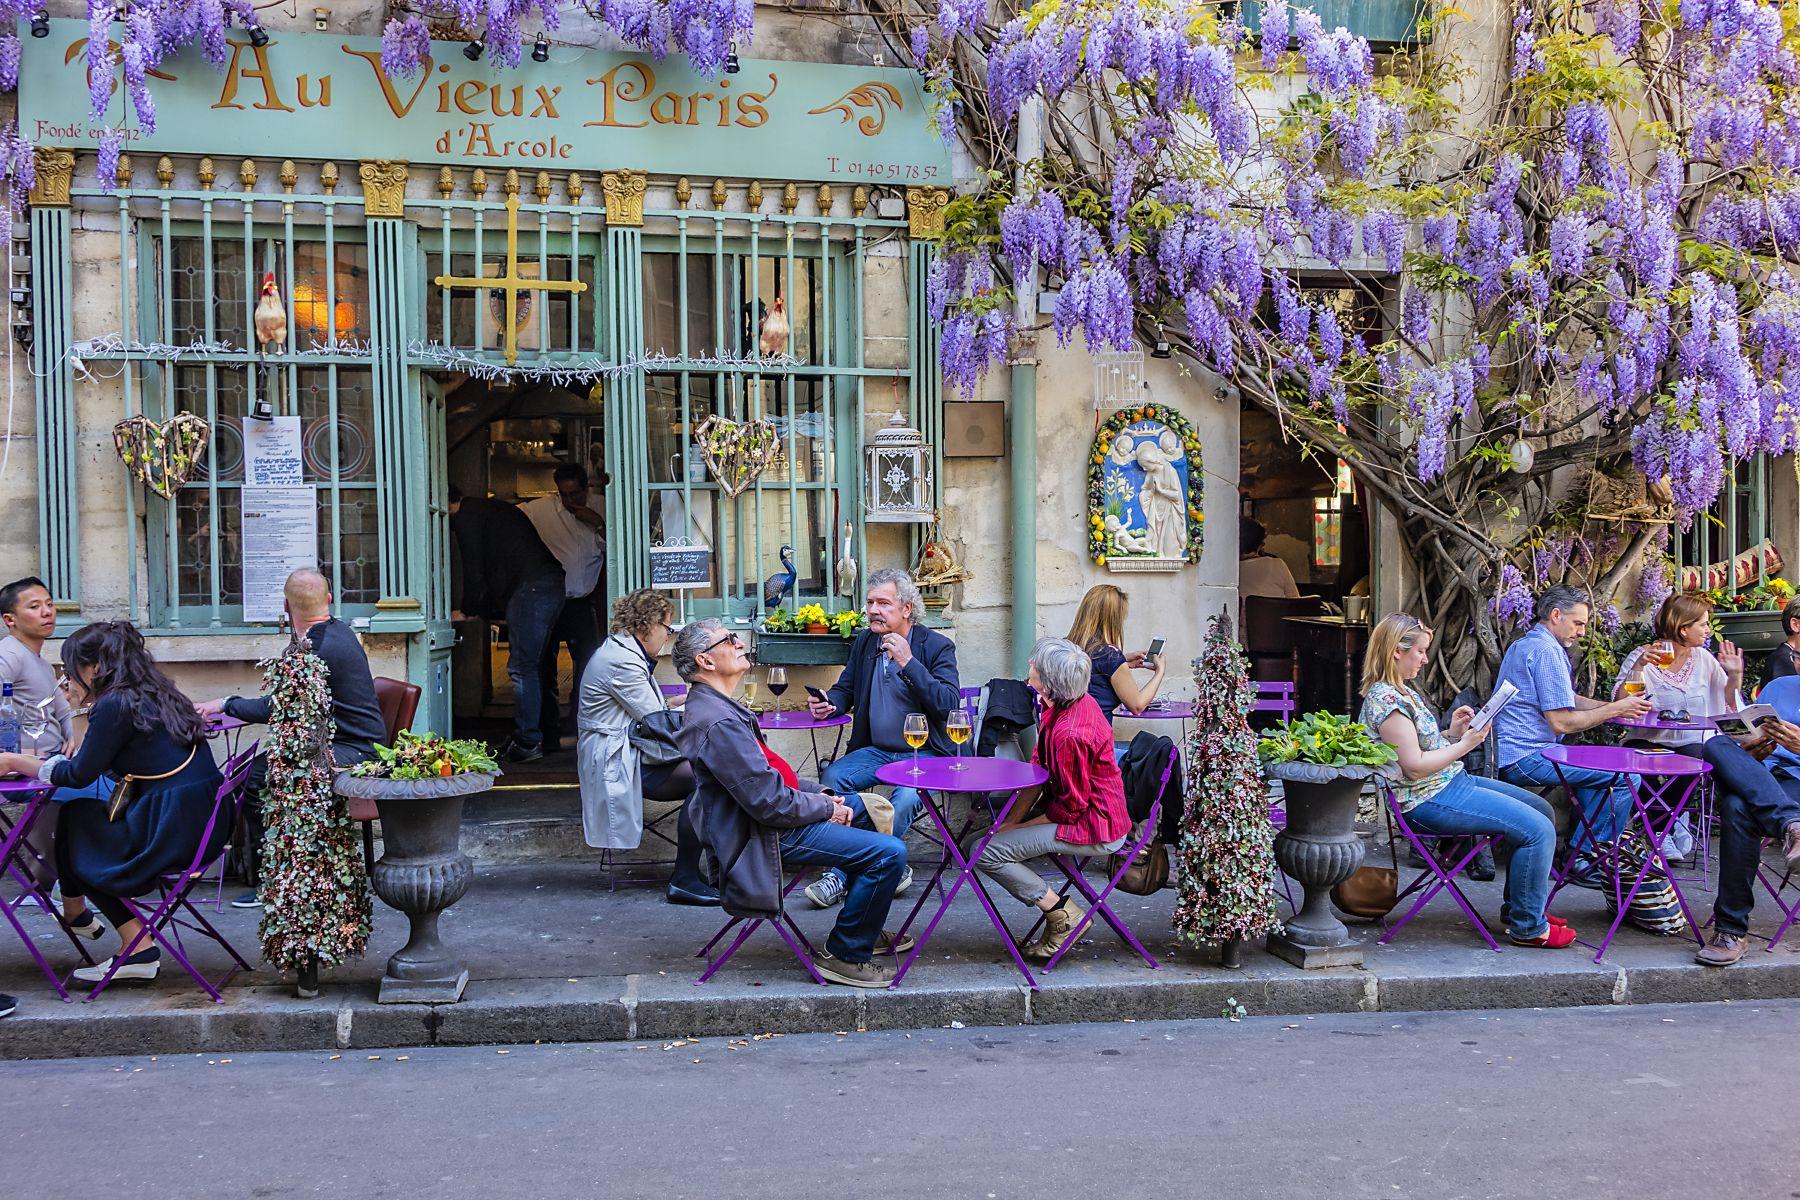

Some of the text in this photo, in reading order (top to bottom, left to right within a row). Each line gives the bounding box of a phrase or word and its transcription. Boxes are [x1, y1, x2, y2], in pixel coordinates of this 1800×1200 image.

[211, 38, 779, 129] Au Vieux Paris
[32, 119, 82, 143] Fondé
[88, 128, 105, 141] en
[436, 121, 573, 159] d'Arcole
[848, 162, 862, 174] 01
[867, 163, 884, 177] 40
[886, 164, 900, 179] 51
[905, 165, 920, 179] 78
[922, 166, 938, 180] 52
